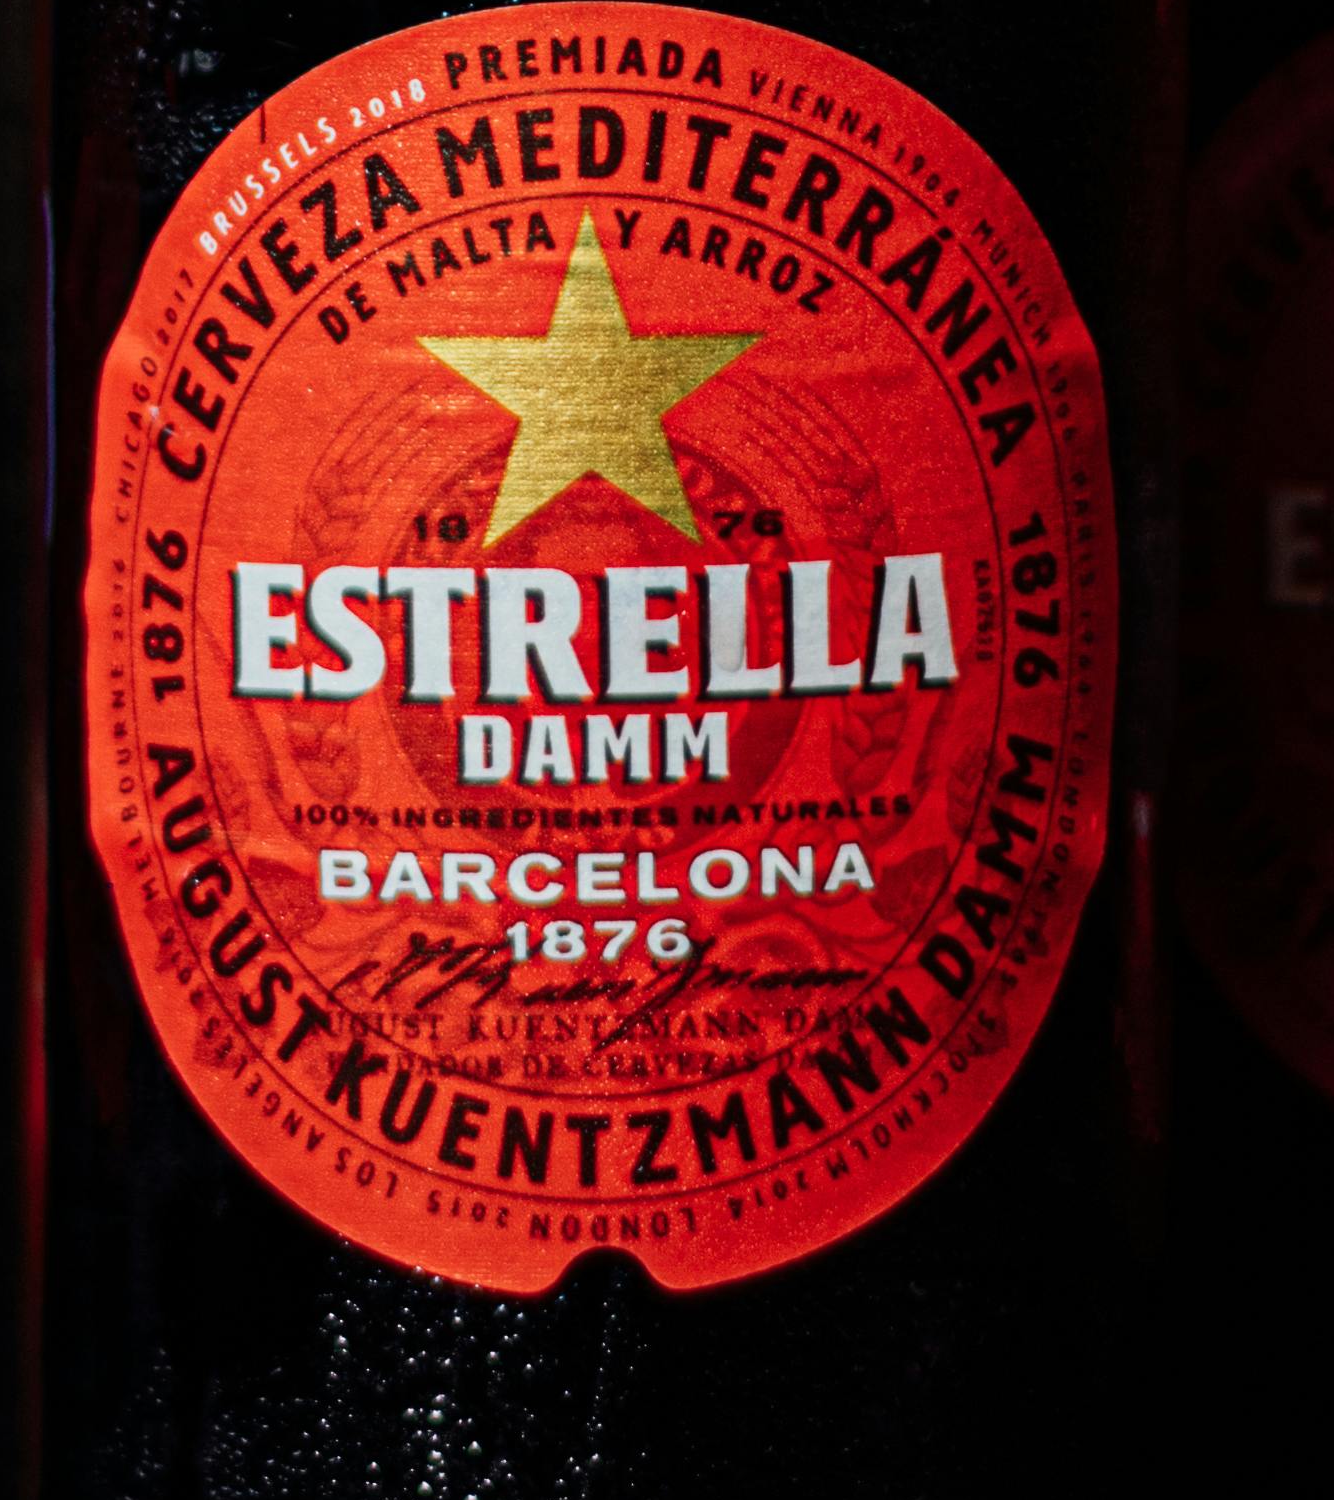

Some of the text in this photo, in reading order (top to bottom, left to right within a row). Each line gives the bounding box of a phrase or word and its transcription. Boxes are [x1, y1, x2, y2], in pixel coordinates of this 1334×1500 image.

[444, 34, 724, 90] PREMIADA
[749, 69, 883, 150] VIENNA
[197, 77, 427, 257] BRUSSELS 2018
[154, 106, 1037, 484] CERVEZA MEDITERRÁNEA
[317, 211, 558, 345] DE MALTA
[614, 208, 836, 314] Y ARROZ
[115, 355, 158, 524] CHICAGO
[413, 509, 784, 544] 18 76
[142, 527, 190, 703] 1876
[231, 552, 960, 704] ESTRELLA
[1008, 510, 1061, 689] 1876
[109, 663, 158, 902] MELBOURNE
[459, 711, 729, 787] DAMM
[292, 794, 912, 831] 100% INGREDIENTES NATURALES
[318, 842, 875, 904] BARCELONA
[146, 741, 331, 1063] AUGUST
[323, 986, 933, 1188] KUENTZMANN
[917, 732, 1057, 1000] DAMM
[505, 917, 693, 963] 1876
[334, 1145, 399, 1199] LOS
[528, 1205, 698, 1244] LONDON
